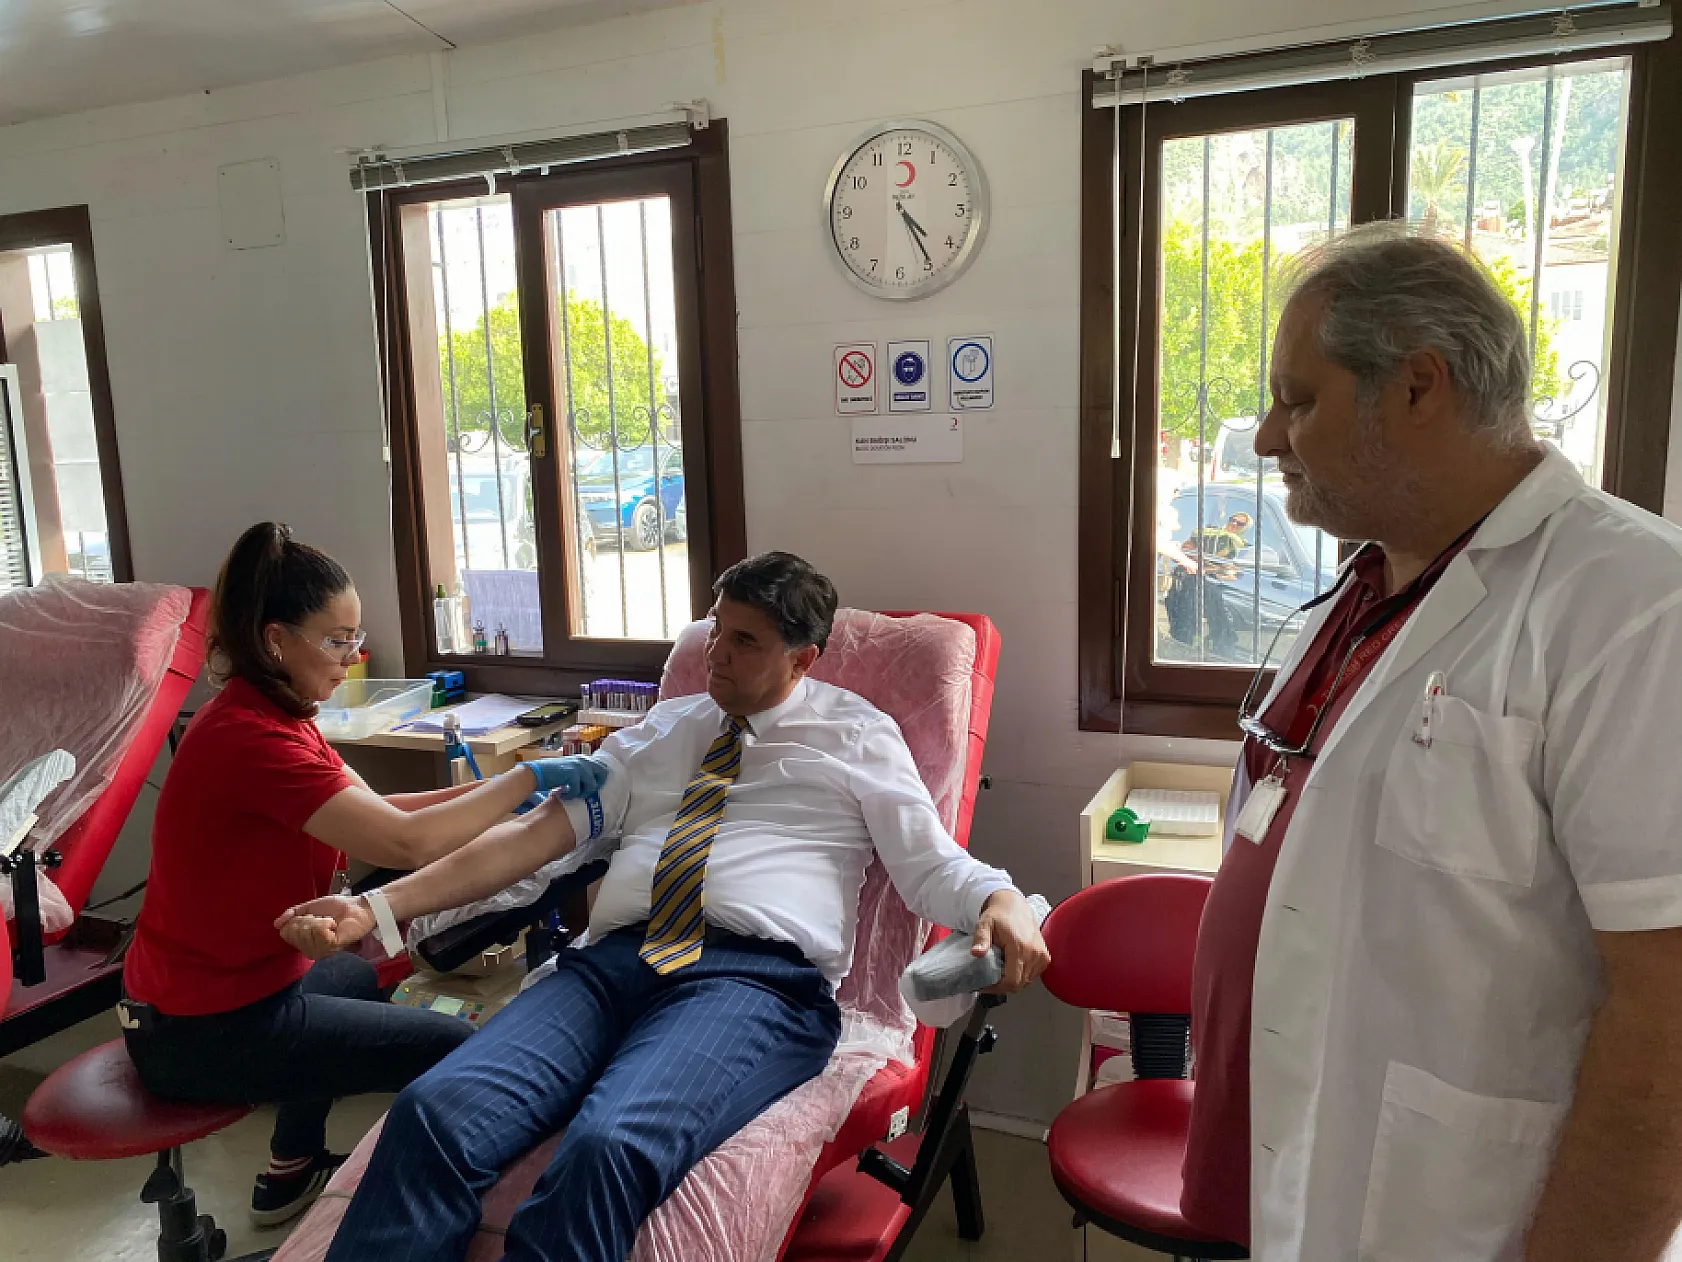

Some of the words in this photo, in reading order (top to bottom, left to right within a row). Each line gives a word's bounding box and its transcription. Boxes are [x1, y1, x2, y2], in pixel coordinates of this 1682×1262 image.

[897, 142, 912, 156] 12
[873, 152, 882, 166] 11
[930, 150, 936, 165] 1
[853, 176, 867, 190] 10
[948, 172, 958, 187] 2
[842, 205, 853, 219] 9
[954, 203, 965, 218] 3
[849, 236, 860, 250] 8
[944, 235, 955, 249] 4
[870, 258, 878, 271] 7
[923, 257, 934, 271] 5
[895, 266, 906, 280] 6
